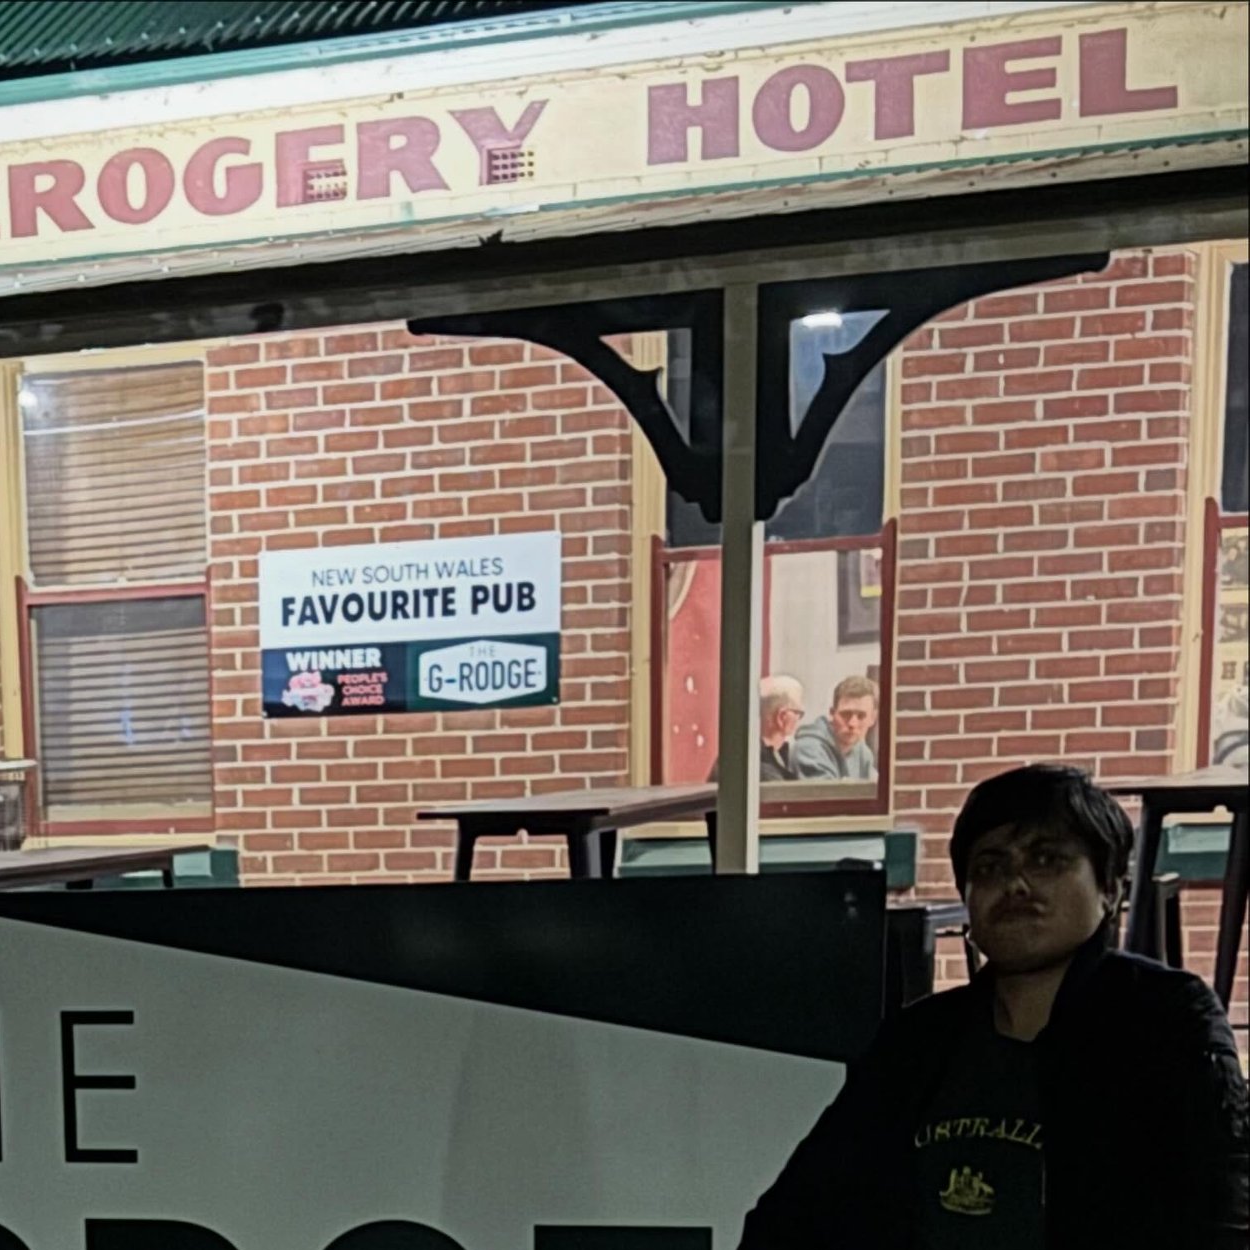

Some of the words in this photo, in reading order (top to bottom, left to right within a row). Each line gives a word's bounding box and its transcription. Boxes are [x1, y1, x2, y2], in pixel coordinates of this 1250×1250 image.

[647, 28, 1178, 166] HOTEL
[312, 568, 356, 587] NEW
[362, 563, 429, 584] SOUTH
[435, 557, 504, 579] WALES
[281, 587, 456, 626] FAVOURITE
[471, 581, 536, 615] PUB
[286, 648, 382, 671] WINNER
[429, 658, 537, 693] G-RODGE
